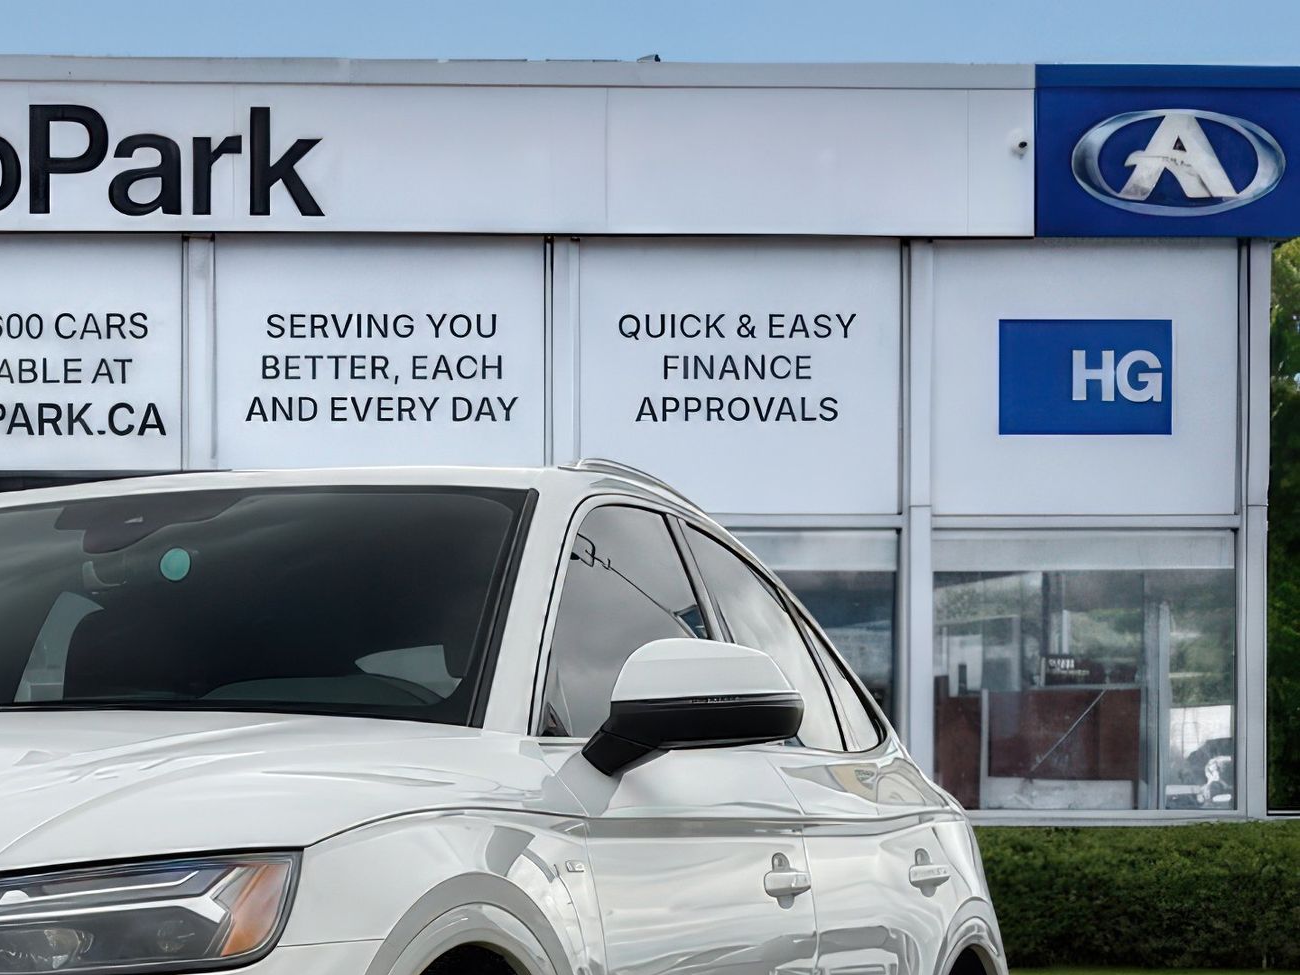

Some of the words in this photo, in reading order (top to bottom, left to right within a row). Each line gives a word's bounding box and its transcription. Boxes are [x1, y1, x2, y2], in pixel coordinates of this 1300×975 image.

[54, 312, 149, 340] CARS
[266, 313, 415, 339] SERVING
[425, 313, 497, 339] YOU
[618, 313, 726, 341] QUICK
[736, 313, 757, 339] &
[768, 313, 857, 339] EASY
[91, 357, 133, 385] AT
[261, 354, 399, 385] BETTER,
[411, 354, 503, 381] EACH
[663, 354, 812, 381] FINANCE
[1072, 350, 1163, 402] HG
[245, 396, 318, 423] AND
[330, 396, 440, 422] EVERY
[452, 396, 519, 422] DAY
[635, 396, 839, 423] APPROVALS
